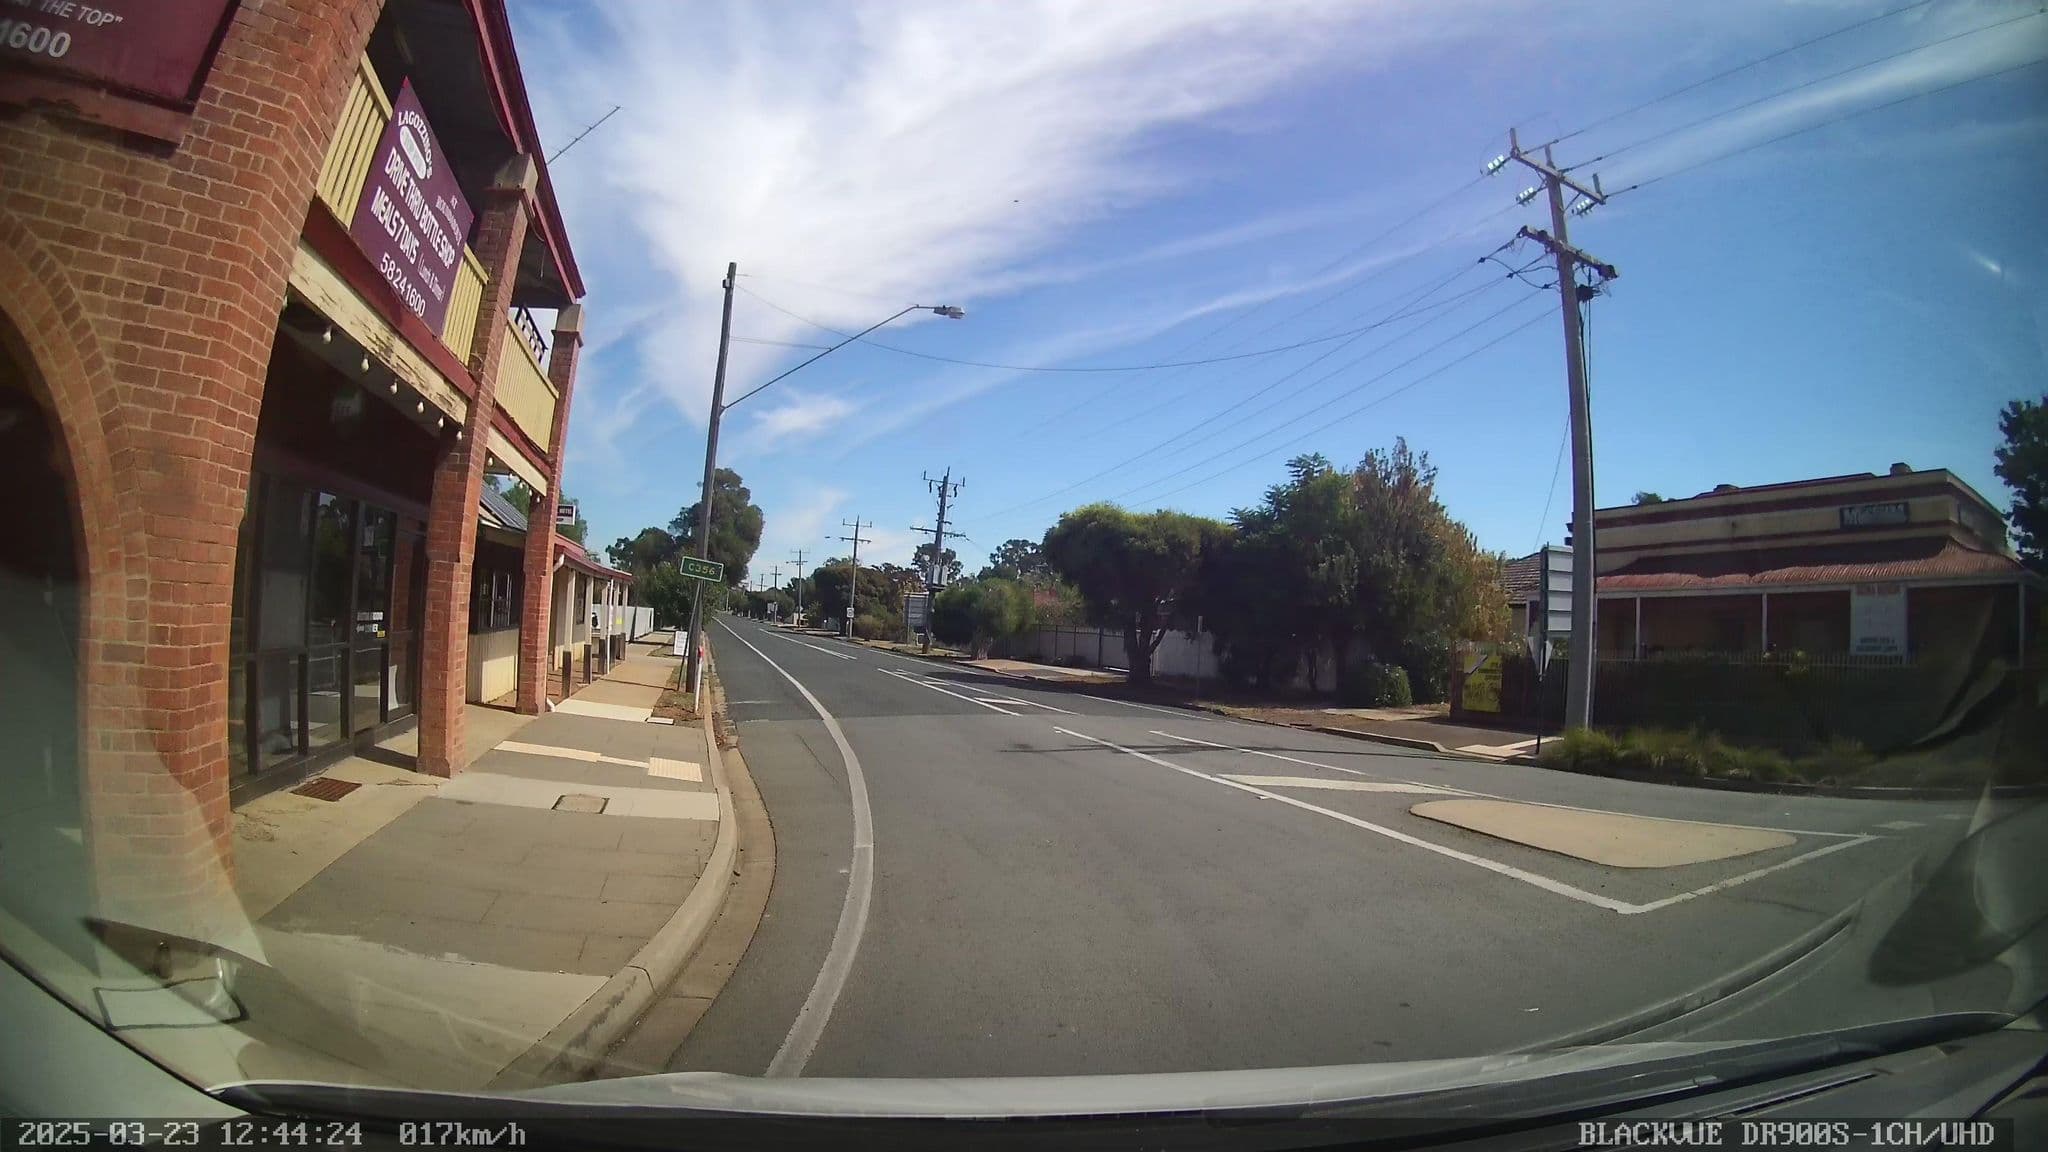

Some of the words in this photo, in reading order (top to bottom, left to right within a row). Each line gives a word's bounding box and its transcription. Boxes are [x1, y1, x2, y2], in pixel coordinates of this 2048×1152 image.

[39, 0, 77, 18] THE
[398, 110, 433, 179] LAGOZZINO'S
[371, 185, 401, 238] MEALS
[394, 217, 406, 242] 7
[400, 225, 420, 264] DAYS
[384, 146, 411, 197] DRIVE
[405, 177, 426, 220] THRU
[419, 203, 443, 253] BOTTLE
[438, 235, 456, 269] SHOP
[381, 252, 426, 318] 58241600
[688, 563, 716, 575] C356
